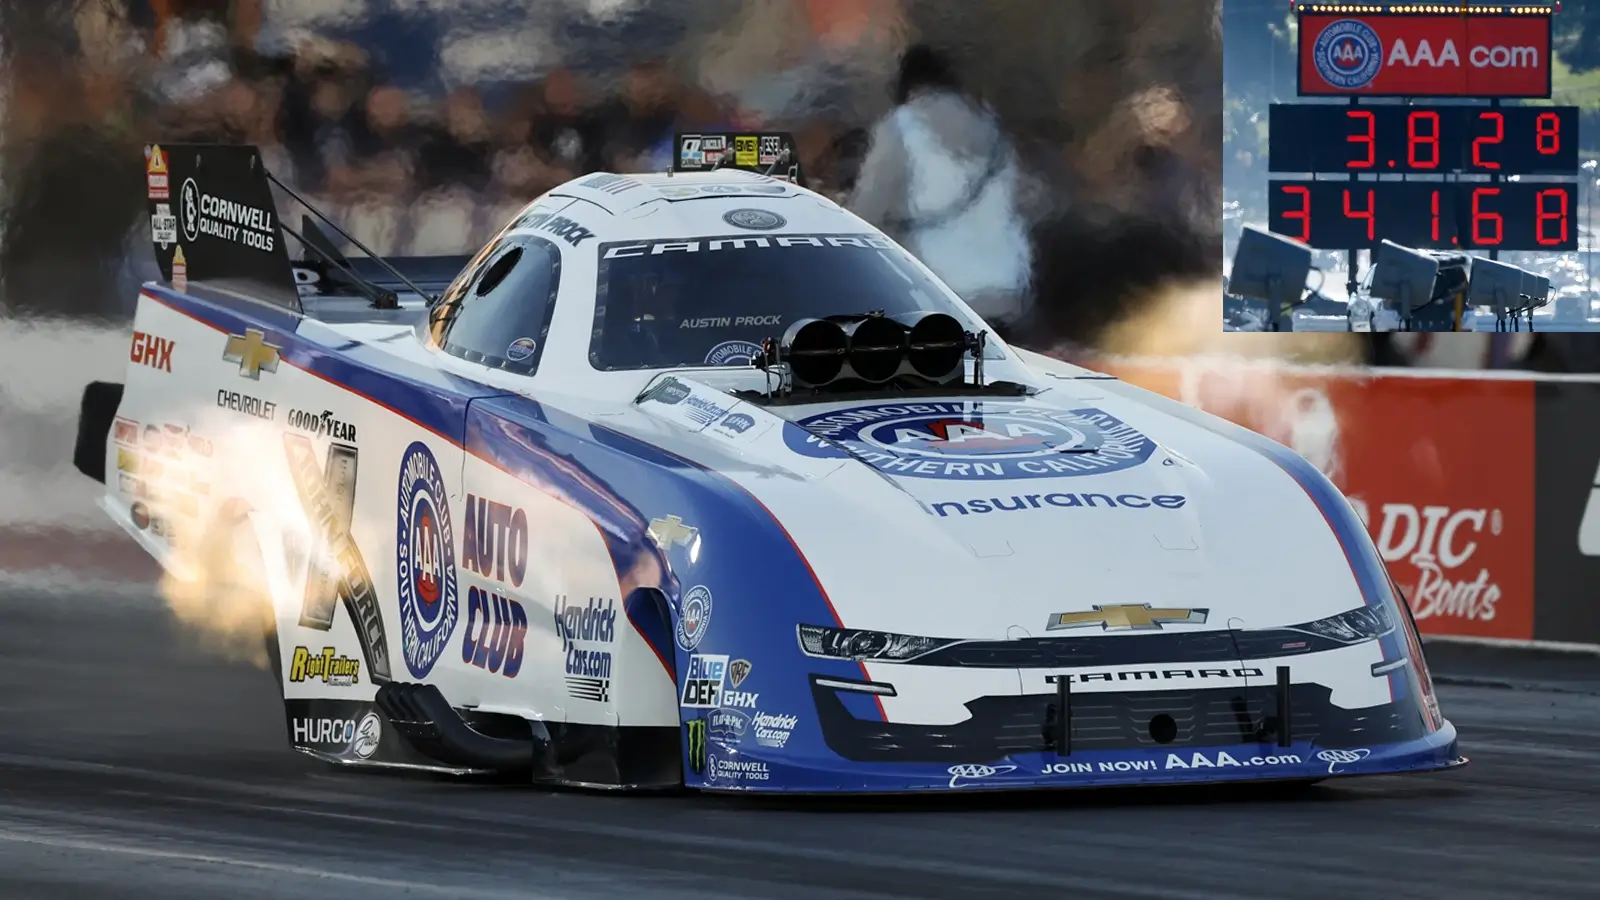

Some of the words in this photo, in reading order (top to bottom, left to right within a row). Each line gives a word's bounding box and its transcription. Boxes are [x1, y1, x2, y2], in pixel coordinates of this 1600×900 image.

[1332, 43, 1364, 62] AAA
[1387, 39, 1460, 67] AAA
[201, 193, 274, 233] CORNWELL
[200, 216, 240, 242] QUALITY
[242, 228, 274, 252] TOOLS
[679, 317, 731, 329] AUSTIN
[735, 315, 783, 327] PROCK
[130, 332, 176, 373] GHX
[217, 389, 277, 421] CHEVROLET
[288, 409, 357, 443] GOODYEAR
[892, 420, 1057, 444] AAA
[400, 451, 435, 529] AUTOMOBILE
[434, 482, 451, 544] CLUB
[462, 493, 529, 588] AUTO
[415, 526, 442, 584] AAA
[399, 544, 419, 667] SOUTHERN
[416, 564, 457, 670] CALIFORNIA
[462, 585, 528, 679] CLUB
[554, 594, 617, 652] Hendrick
[566, 641, 612, 678] Cars.com
[689, 657, 724, 680] Blue
[1045, 668, 1264, 684] CAMARO
[683, 680, 721, 705] DEF
[723, 690, 759, 708] GHX
[293, 718, 356, 744] HURCO
[752, 711, 798, 731] Hendrick
[756, 727, 790, 741] Cars.com
[717, 769, 742, 779] QUALITY
[745, 771, 770, 780] TOOLS
[718, 760, 770, 772] CORNWELL
[1041, 763, 1092, 774] JOIN
[1098, 760, 1157, 772] NOW!
[1165, 752, 1301, 769] AAA.com
